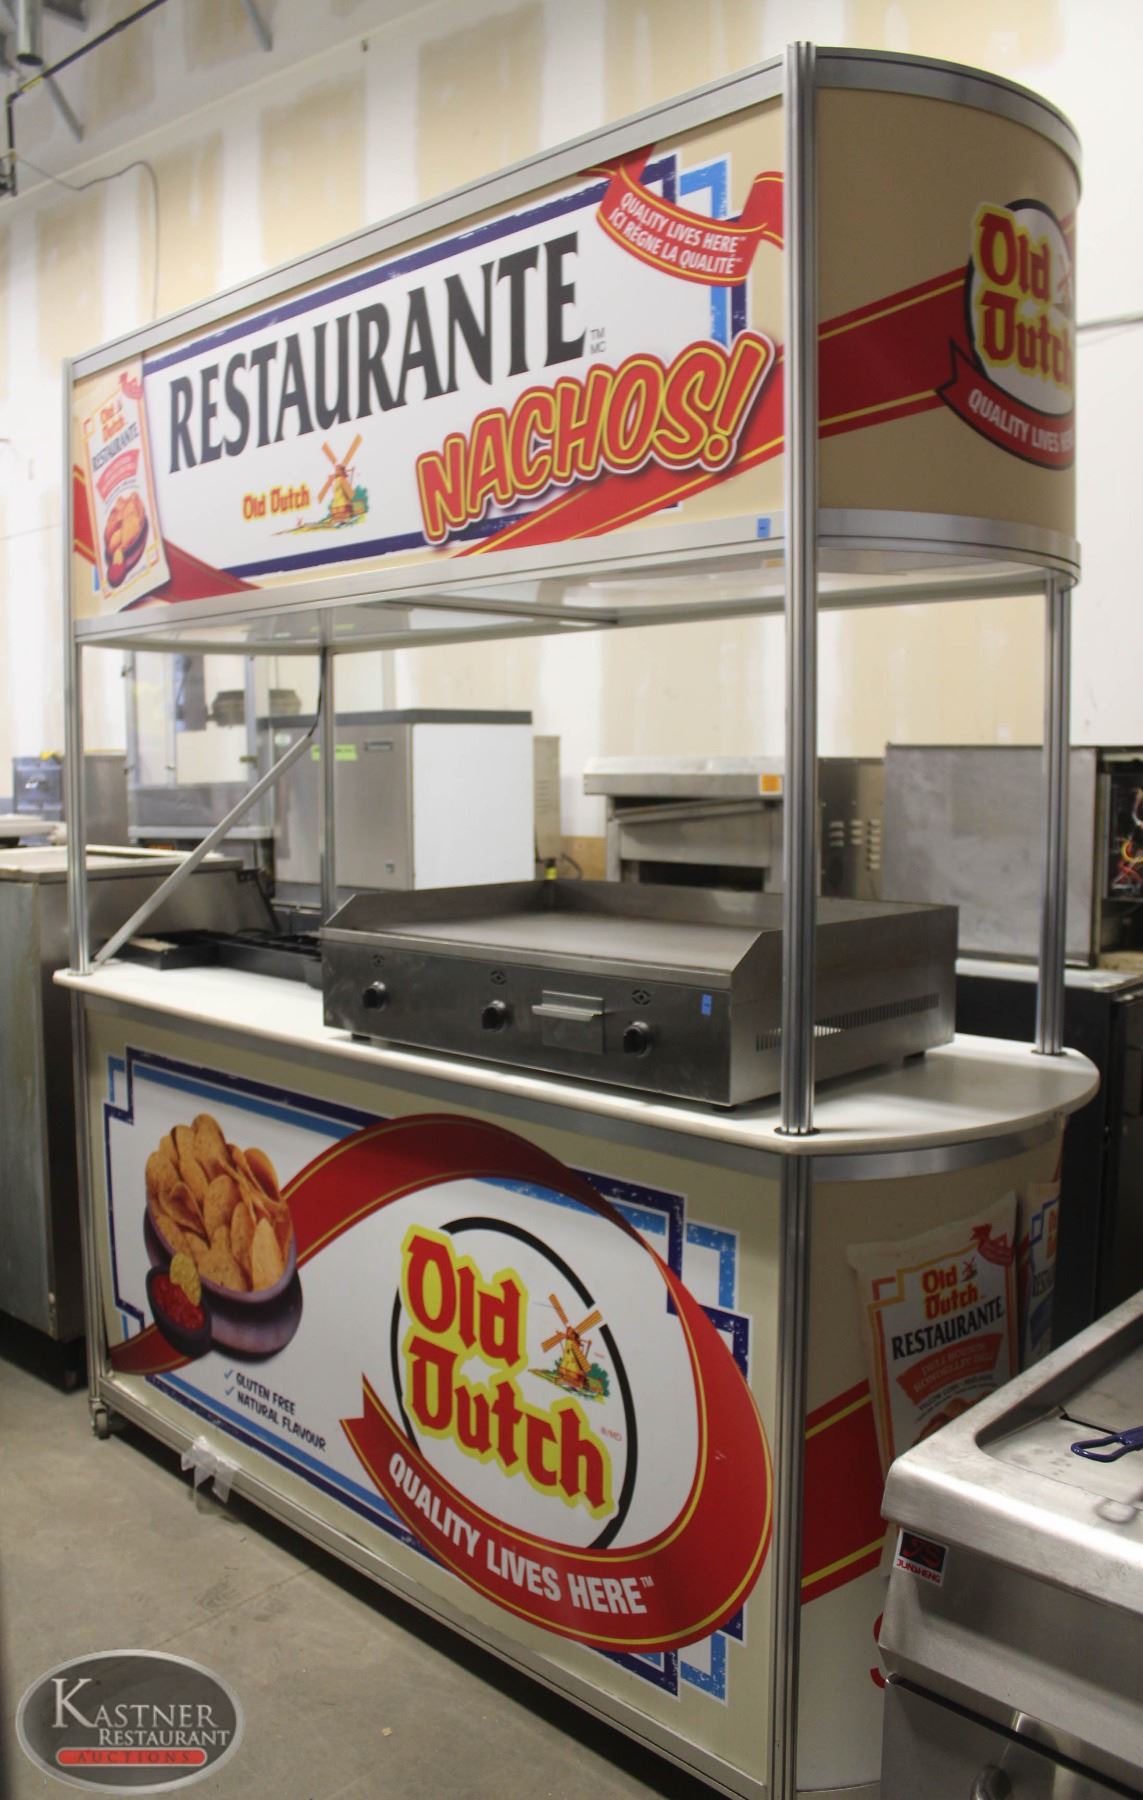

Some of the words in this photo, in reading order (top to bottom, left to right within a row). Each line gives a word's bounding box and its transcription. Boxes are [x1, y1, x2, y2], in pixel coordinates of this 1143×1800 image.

[608, 207, 627, 229] ICI
[661, 242, 678, 262] LA
[679, 250, 735, 275] QUALITÉ
[621, 192, 669, 232] QUALITY
[666, 221, 702, 246] LIVES
[702, 233, 739, 253] HERE
[979, 212, 1050, 302] Old
[169, 231, 587, 474] RESTAURANTE
[416, 330, 774, 544] NACHOS!
[969, 388, 1029, 443] QUALITY
[243, 493, 266, 519] Old
[270, 484, 310, 512] Dutch
[406, 1233, 521, 1367] Old
[921, 1264, 957, 1293] Old
[925, 1282, 978, 1320] Dutch
[891, 1296, 1005, 1360] RESTAURANTE
[236, 1372, 269, 1401] GLUTEN
[272, 1391, 296, 1415] FREE
[238, 1391, 279, 1424] NATURAL
[282, 1416, 326, 1452] FLAVOUR
[408, 1335, 606, 1509] Dutch
[389, 1453, 480, 1558] QUALITY
[486, 1538, 561, 1602] LIVES
[567, 1573, 647, 1615] HERE
[896, 1558, 942, 1585] JUNSHENG
